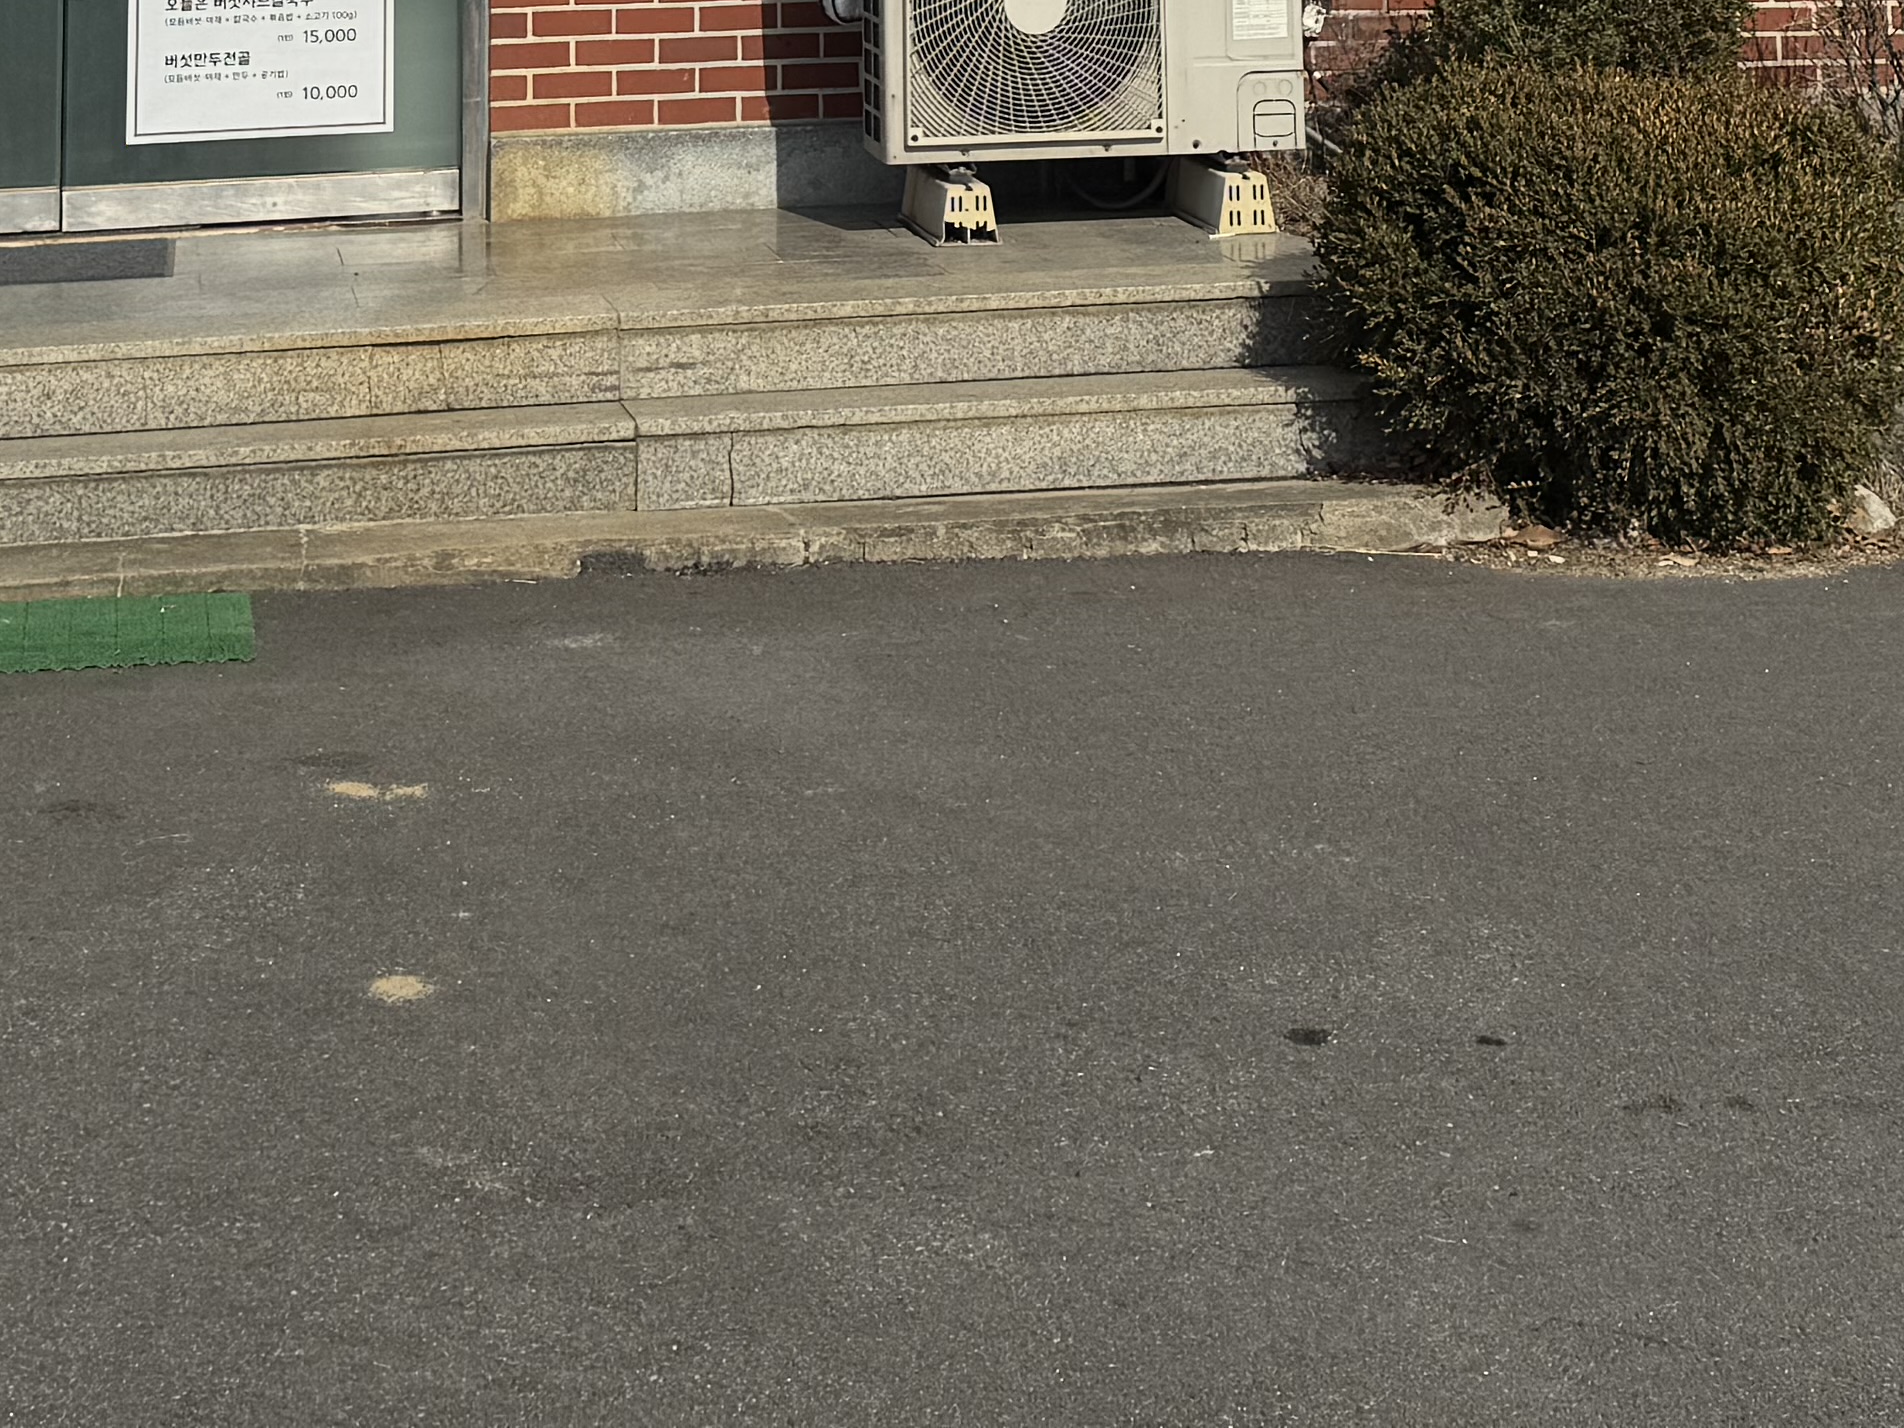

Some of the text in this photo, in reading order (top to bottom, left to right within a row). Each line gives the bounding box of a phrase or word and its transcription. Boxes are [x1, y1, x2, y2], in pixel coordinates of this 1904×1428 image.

[303, 28, 357, 44] 15,000
[165, 51, 251, 68] 버섯만두전골
[303, 85, 358, 100] 10,000
